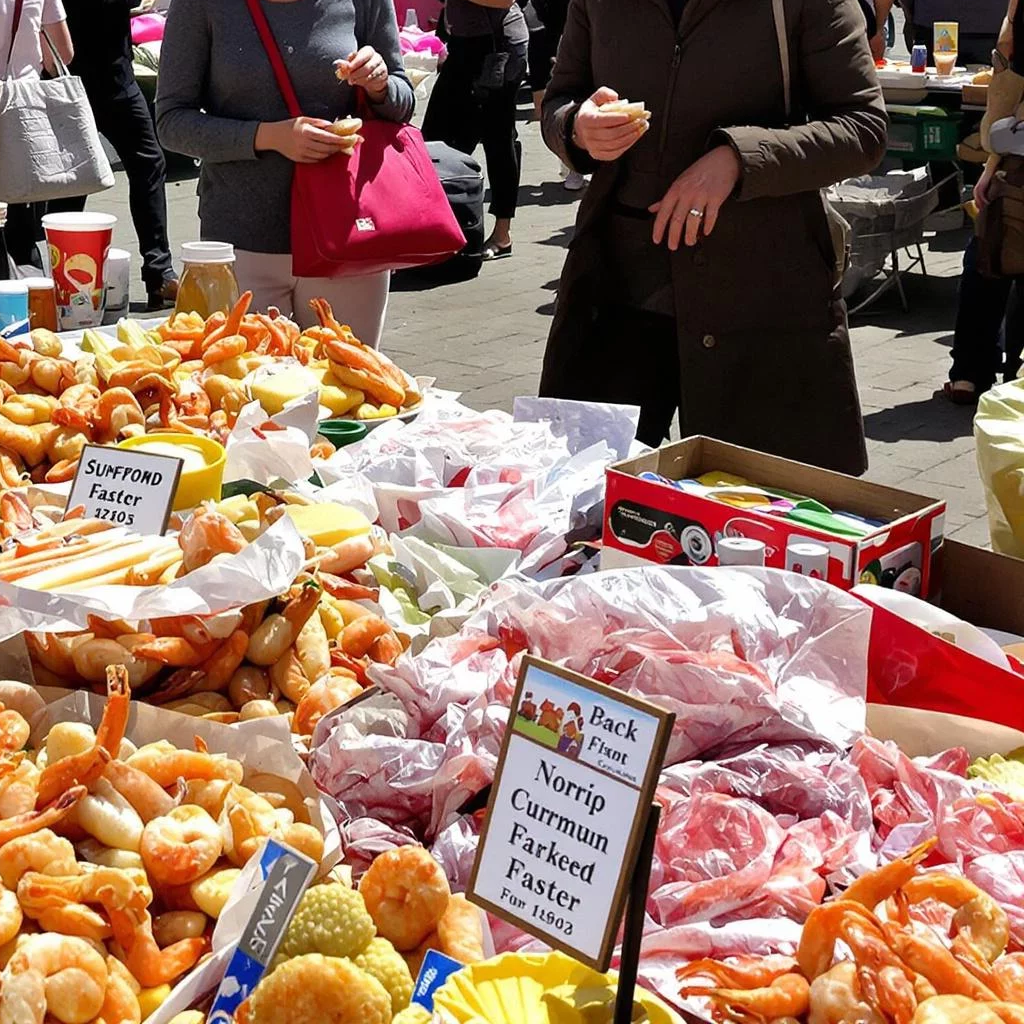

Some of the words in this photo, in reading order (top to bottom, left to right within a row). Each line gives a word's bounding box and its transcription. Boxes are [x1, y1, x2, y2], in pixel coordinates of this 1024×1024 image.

[89, 483, 142, 506] Faster
[588, 705, 639, 742] Back
[534, 759, 605, 815] Norrip
[508, 822, 596, 885] Farkeed
[505, 857, 580, 912] Faster
